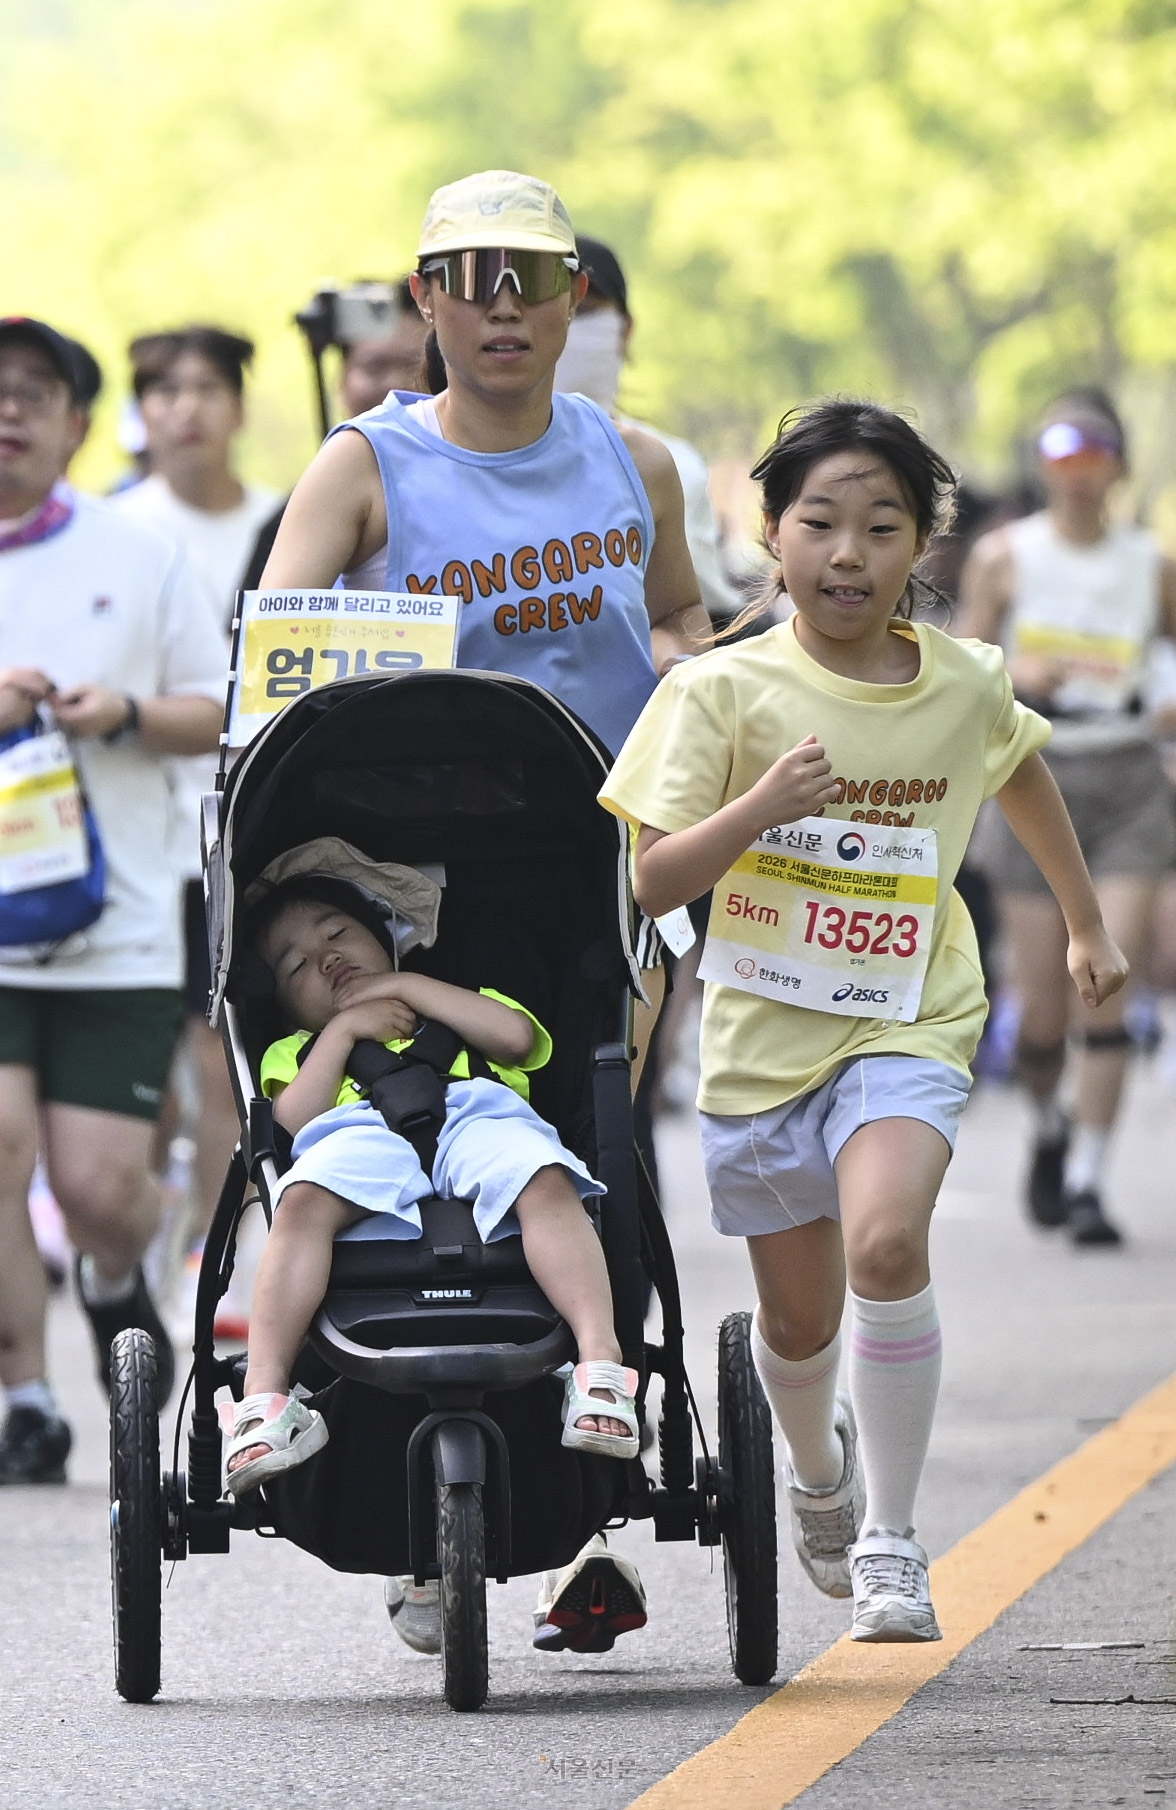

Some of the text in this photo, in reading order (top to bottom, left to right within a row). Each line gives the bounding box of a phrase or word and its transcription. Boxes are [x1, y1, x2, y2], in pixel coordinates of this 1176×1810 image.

[259, 596, 444, 616] 아이와 함께 달리고 있어요
[494, 585, 603, 636] CREW
[828, 777, 948, 807] ANGAROO
[758, 826, 823, 853] 울신문
[872, 844, 923, 861] 인사혁신처
[757, 853, 787, 868] 2026
[756, 866, 896, 898] SEOUL SHINMUN HALF MARATHON
[725, 893, 779, 927] 5km
[803, 901, 919, 957] 13523
[759, 968, 802, 989] 한화생명
[421, 1289, 472, 1299] THULE
